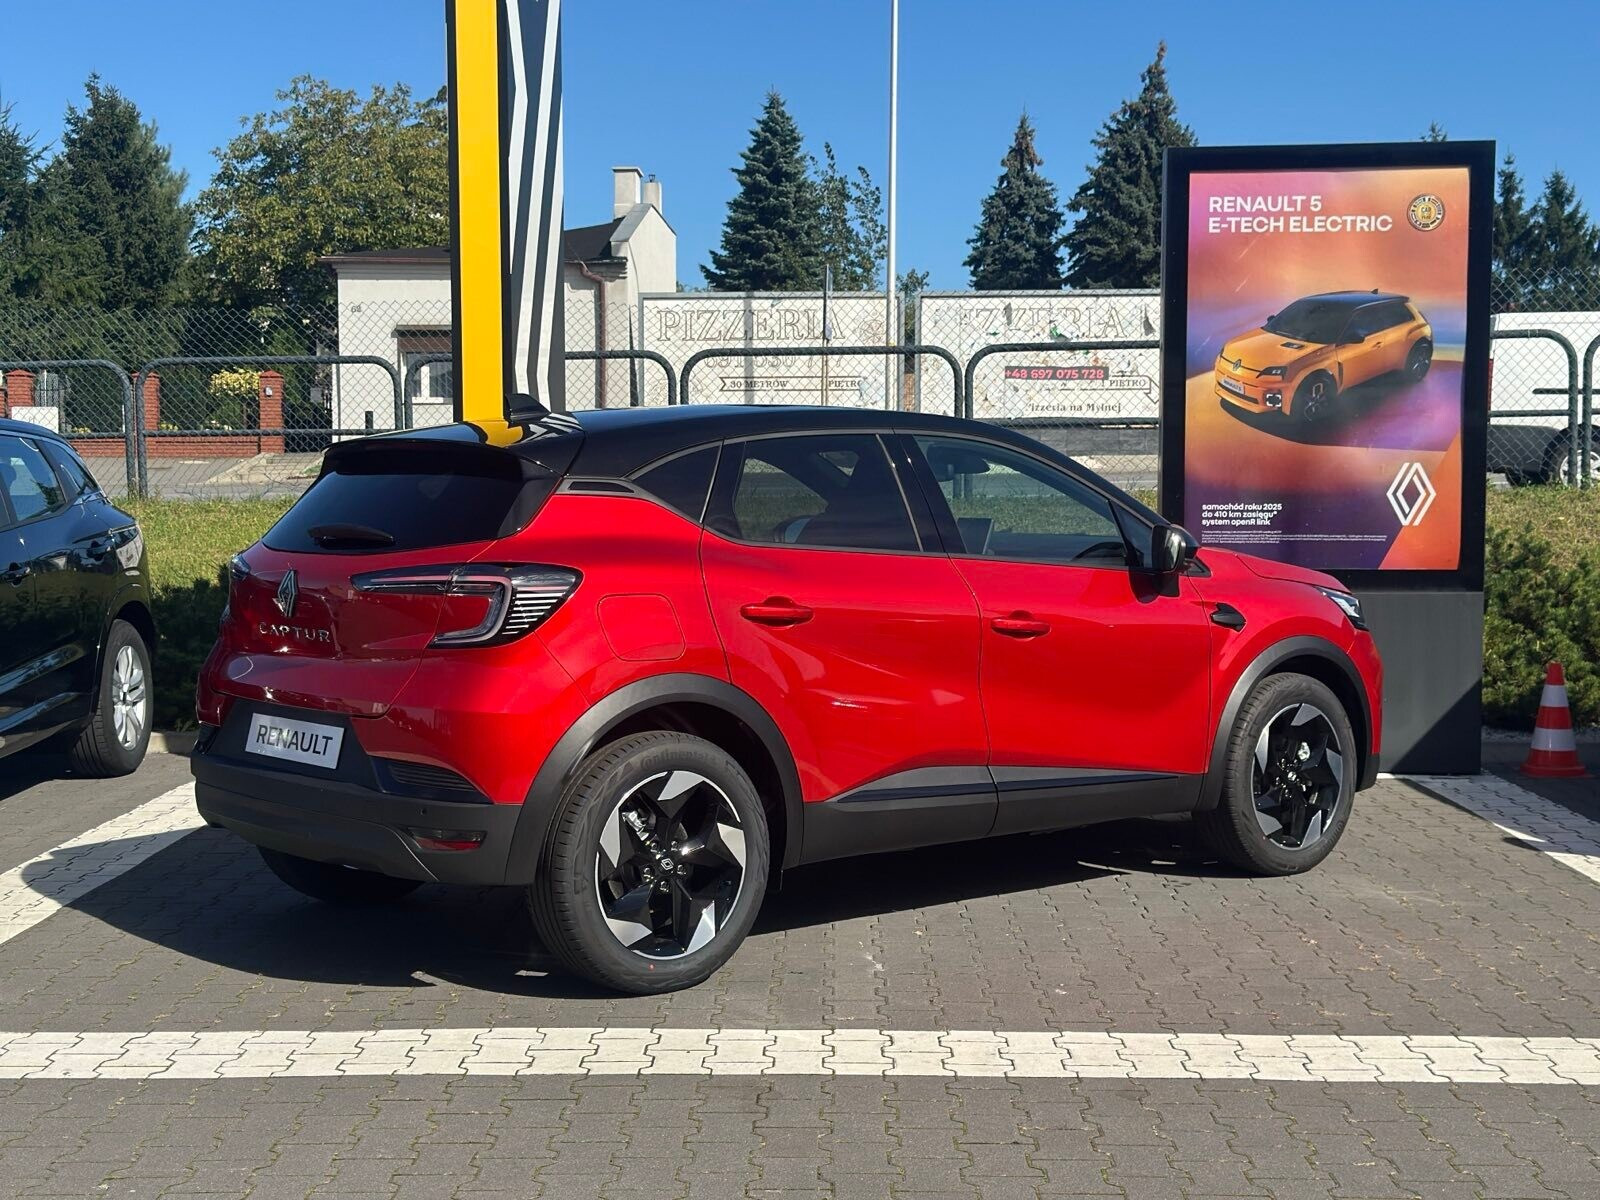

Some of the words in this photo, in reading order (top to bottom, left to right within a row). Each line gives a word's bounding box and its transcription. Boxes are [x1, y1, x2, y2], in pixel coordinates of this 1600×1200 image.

[1209, 195, 1307, 212] RENAULT
[1310, 195, 1322, 212] 5
[1208, 216, 1285, 233] E-TECH
[1289, 214, 1393, 233] ELECTRIC
[1005, 369, 1028, 379] +48
[1031, 369, 1053, 379] 697
[1056, 369, 1079, 379] 075
[1081, 369, 1104, 379] 728
[1202, 502, 1244, 511] samochód
[1245, 503, 1262, 511] roku
[1263, 503, 1283, 511] 2025
[1202, 510, 1213, 518] do
[1229, 510, 1241, 518] km
[1202, 519, 1230, 527] system
[1231, 519, 1255, 527] openR
[1257, 518, 1271, 526] link
[259, 622, 331, 643] CAPTUR
[256, 724, 334, 756] RENAULT
